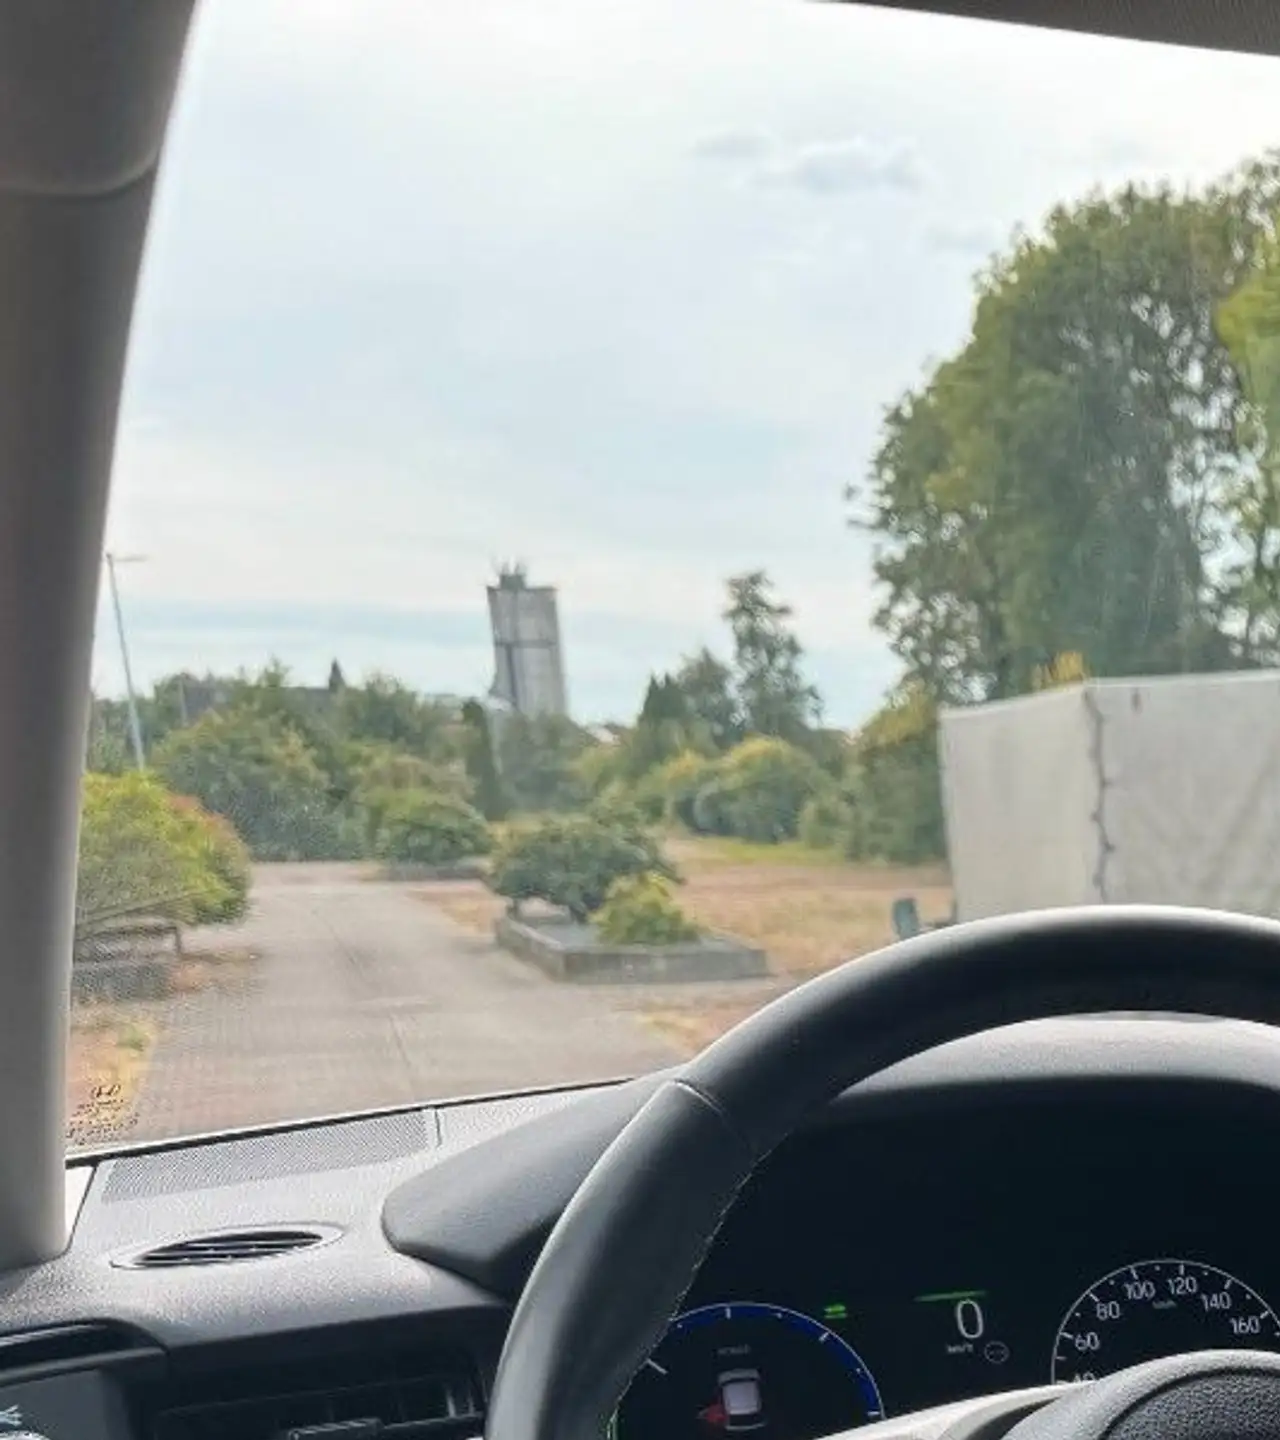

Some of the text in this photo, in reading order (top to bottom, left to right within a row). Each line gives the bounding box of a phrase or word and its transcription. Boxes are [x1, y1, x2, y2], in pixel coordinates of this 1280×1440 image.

[1123, 1281, 1156, 1300] 100
[1168, 1276, 1198, 1295] 120
[1096, 1300, 1121, 1321] 80
[1202, 1291, 1232, 1311] 140
[957, 1299, 983, 1338] 0
[1231, 1317, 1260, 1334] 160
[1074, 1331, 1100, 1351] 60
